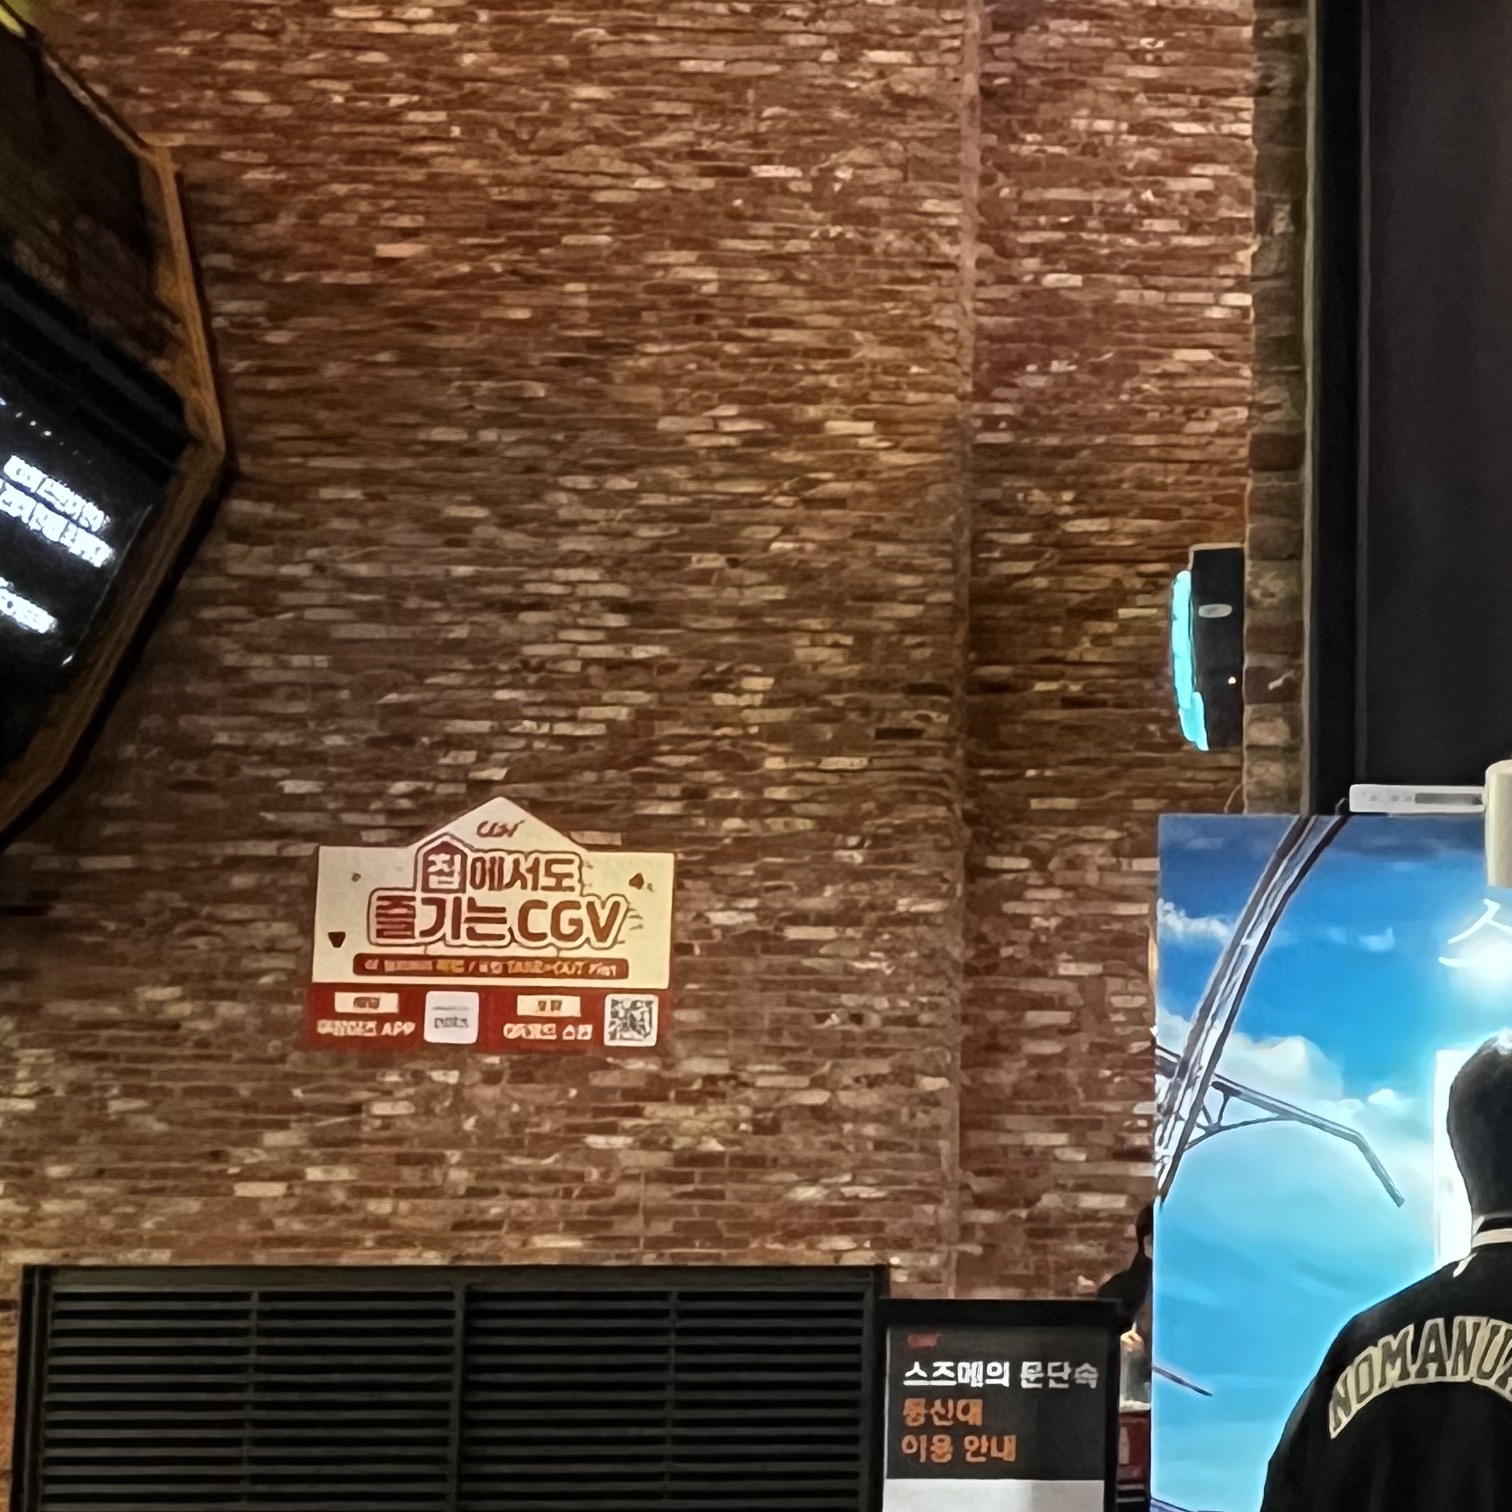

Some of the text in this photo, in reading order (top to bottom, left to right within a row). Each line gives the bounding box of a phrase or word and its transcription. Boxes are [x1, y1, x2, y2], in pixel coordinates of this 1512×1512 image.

[422, 848, 578, 894] 집에서도
[375, 894, 622, 944] 즐기는 CGV
[1020, 1360, 1099, 1390] 문단속
[901, 1433, 1017, 1464] 이용 안내
